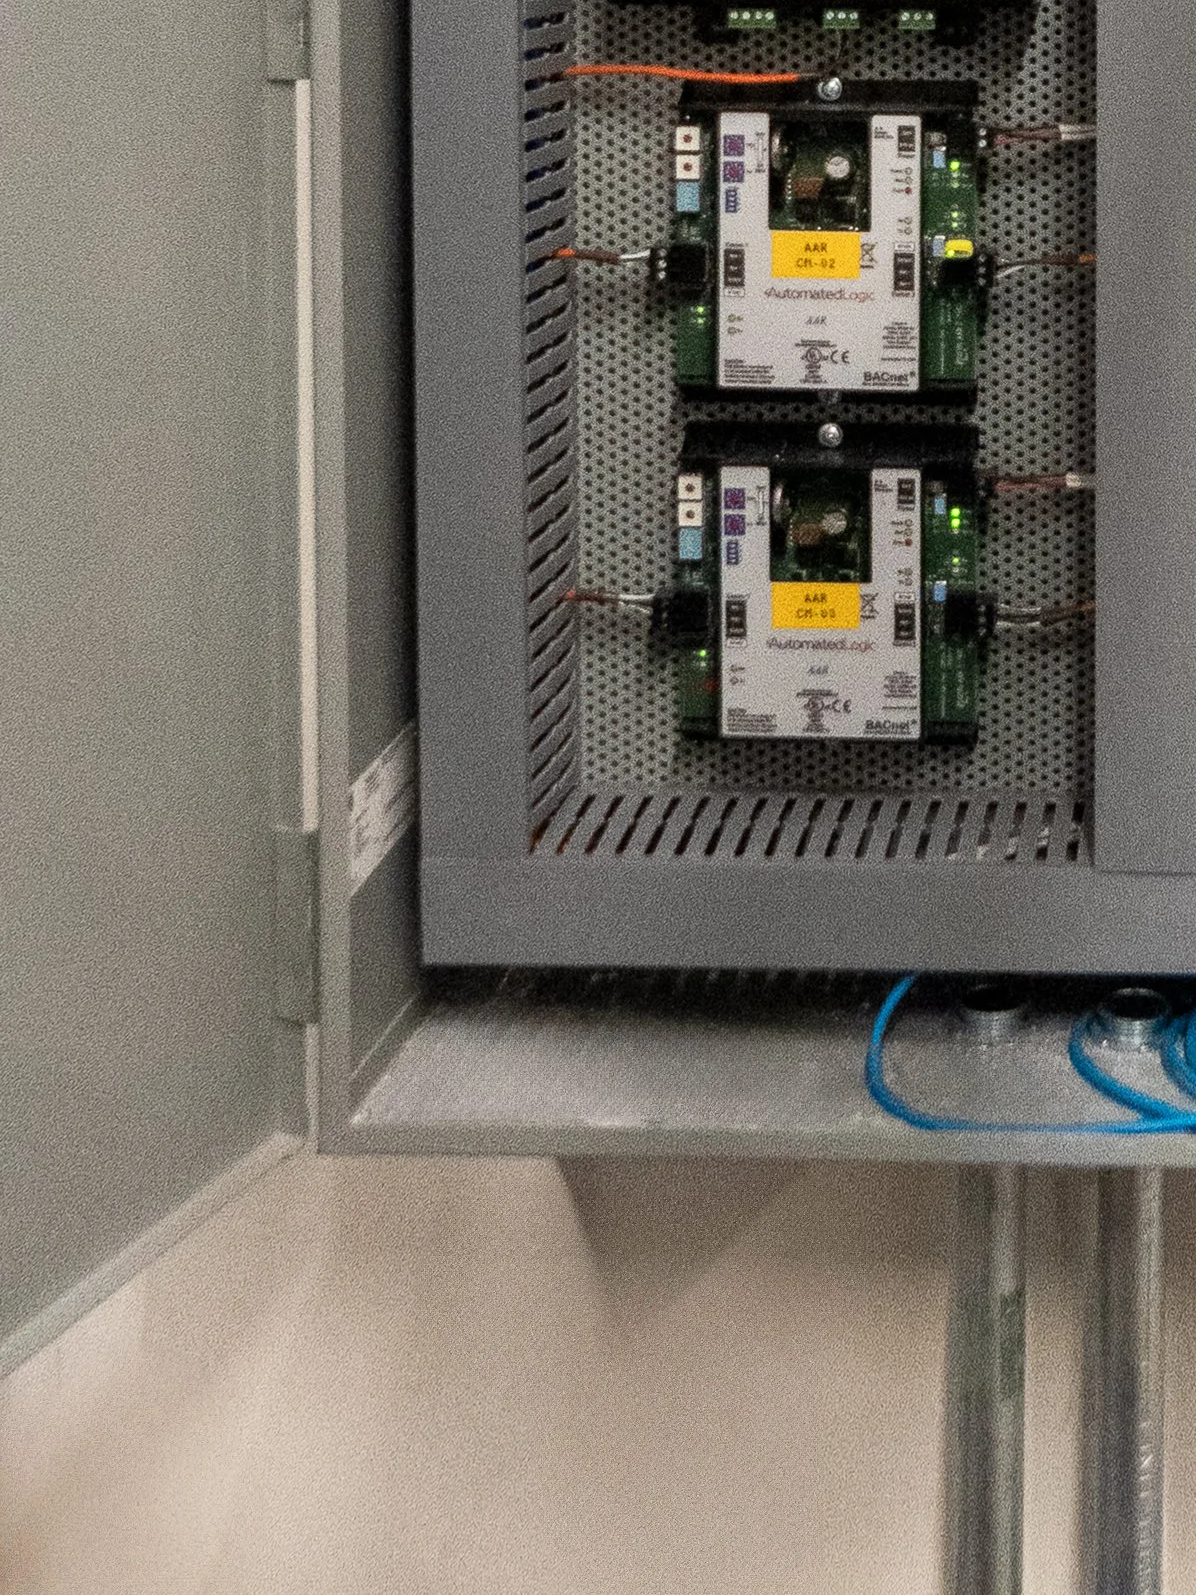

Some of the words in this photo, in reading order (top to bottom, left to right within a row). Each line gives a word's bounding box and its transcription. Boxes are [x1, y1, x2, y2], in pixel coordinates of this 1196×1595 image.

[804, 242, 828, 253] AAR
[795, 258, 836, 270] CM-02
[804, 593, 828, 604] AAR
